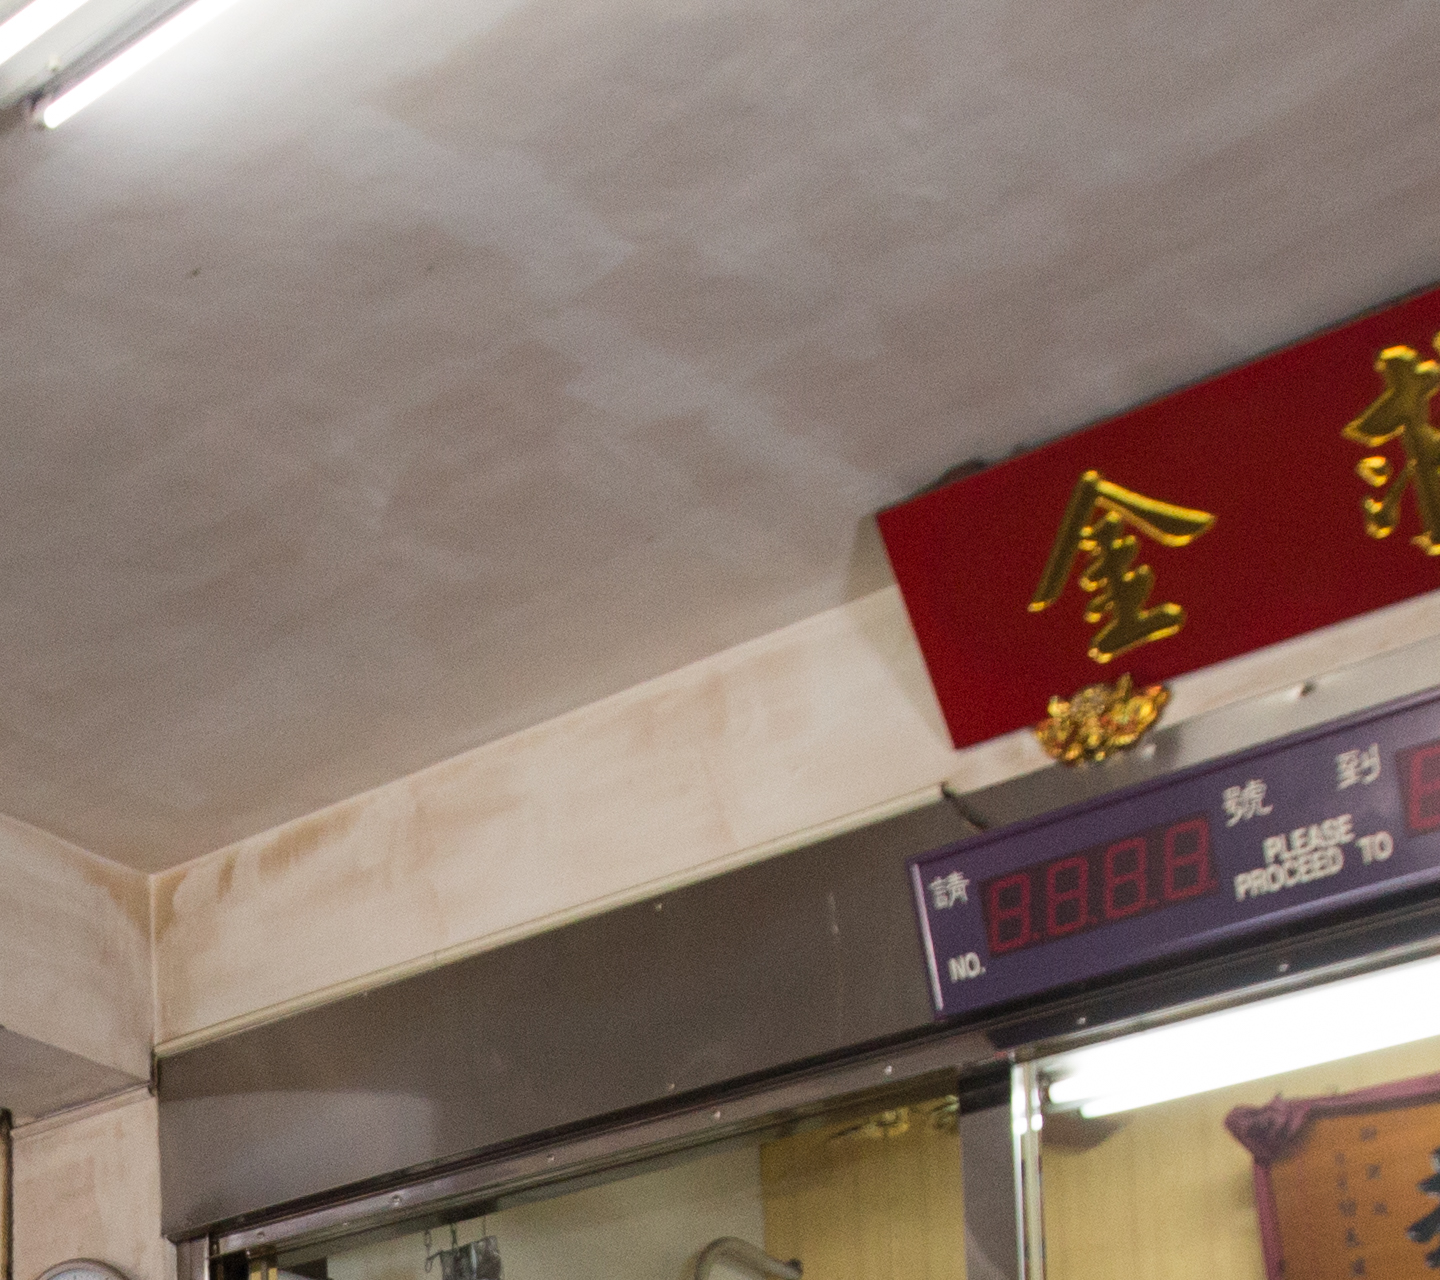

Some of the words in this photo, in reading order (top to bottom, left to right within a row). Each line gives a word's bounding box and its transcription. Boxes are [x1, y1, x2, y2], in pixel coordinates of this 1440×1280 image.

[1263, 813, 1355, 861] PLEASE
[931, 872, 970, 908] 請
[1235, 848, 1344, 902] PROCEED
[1357, 833, 1393, 864] TO
